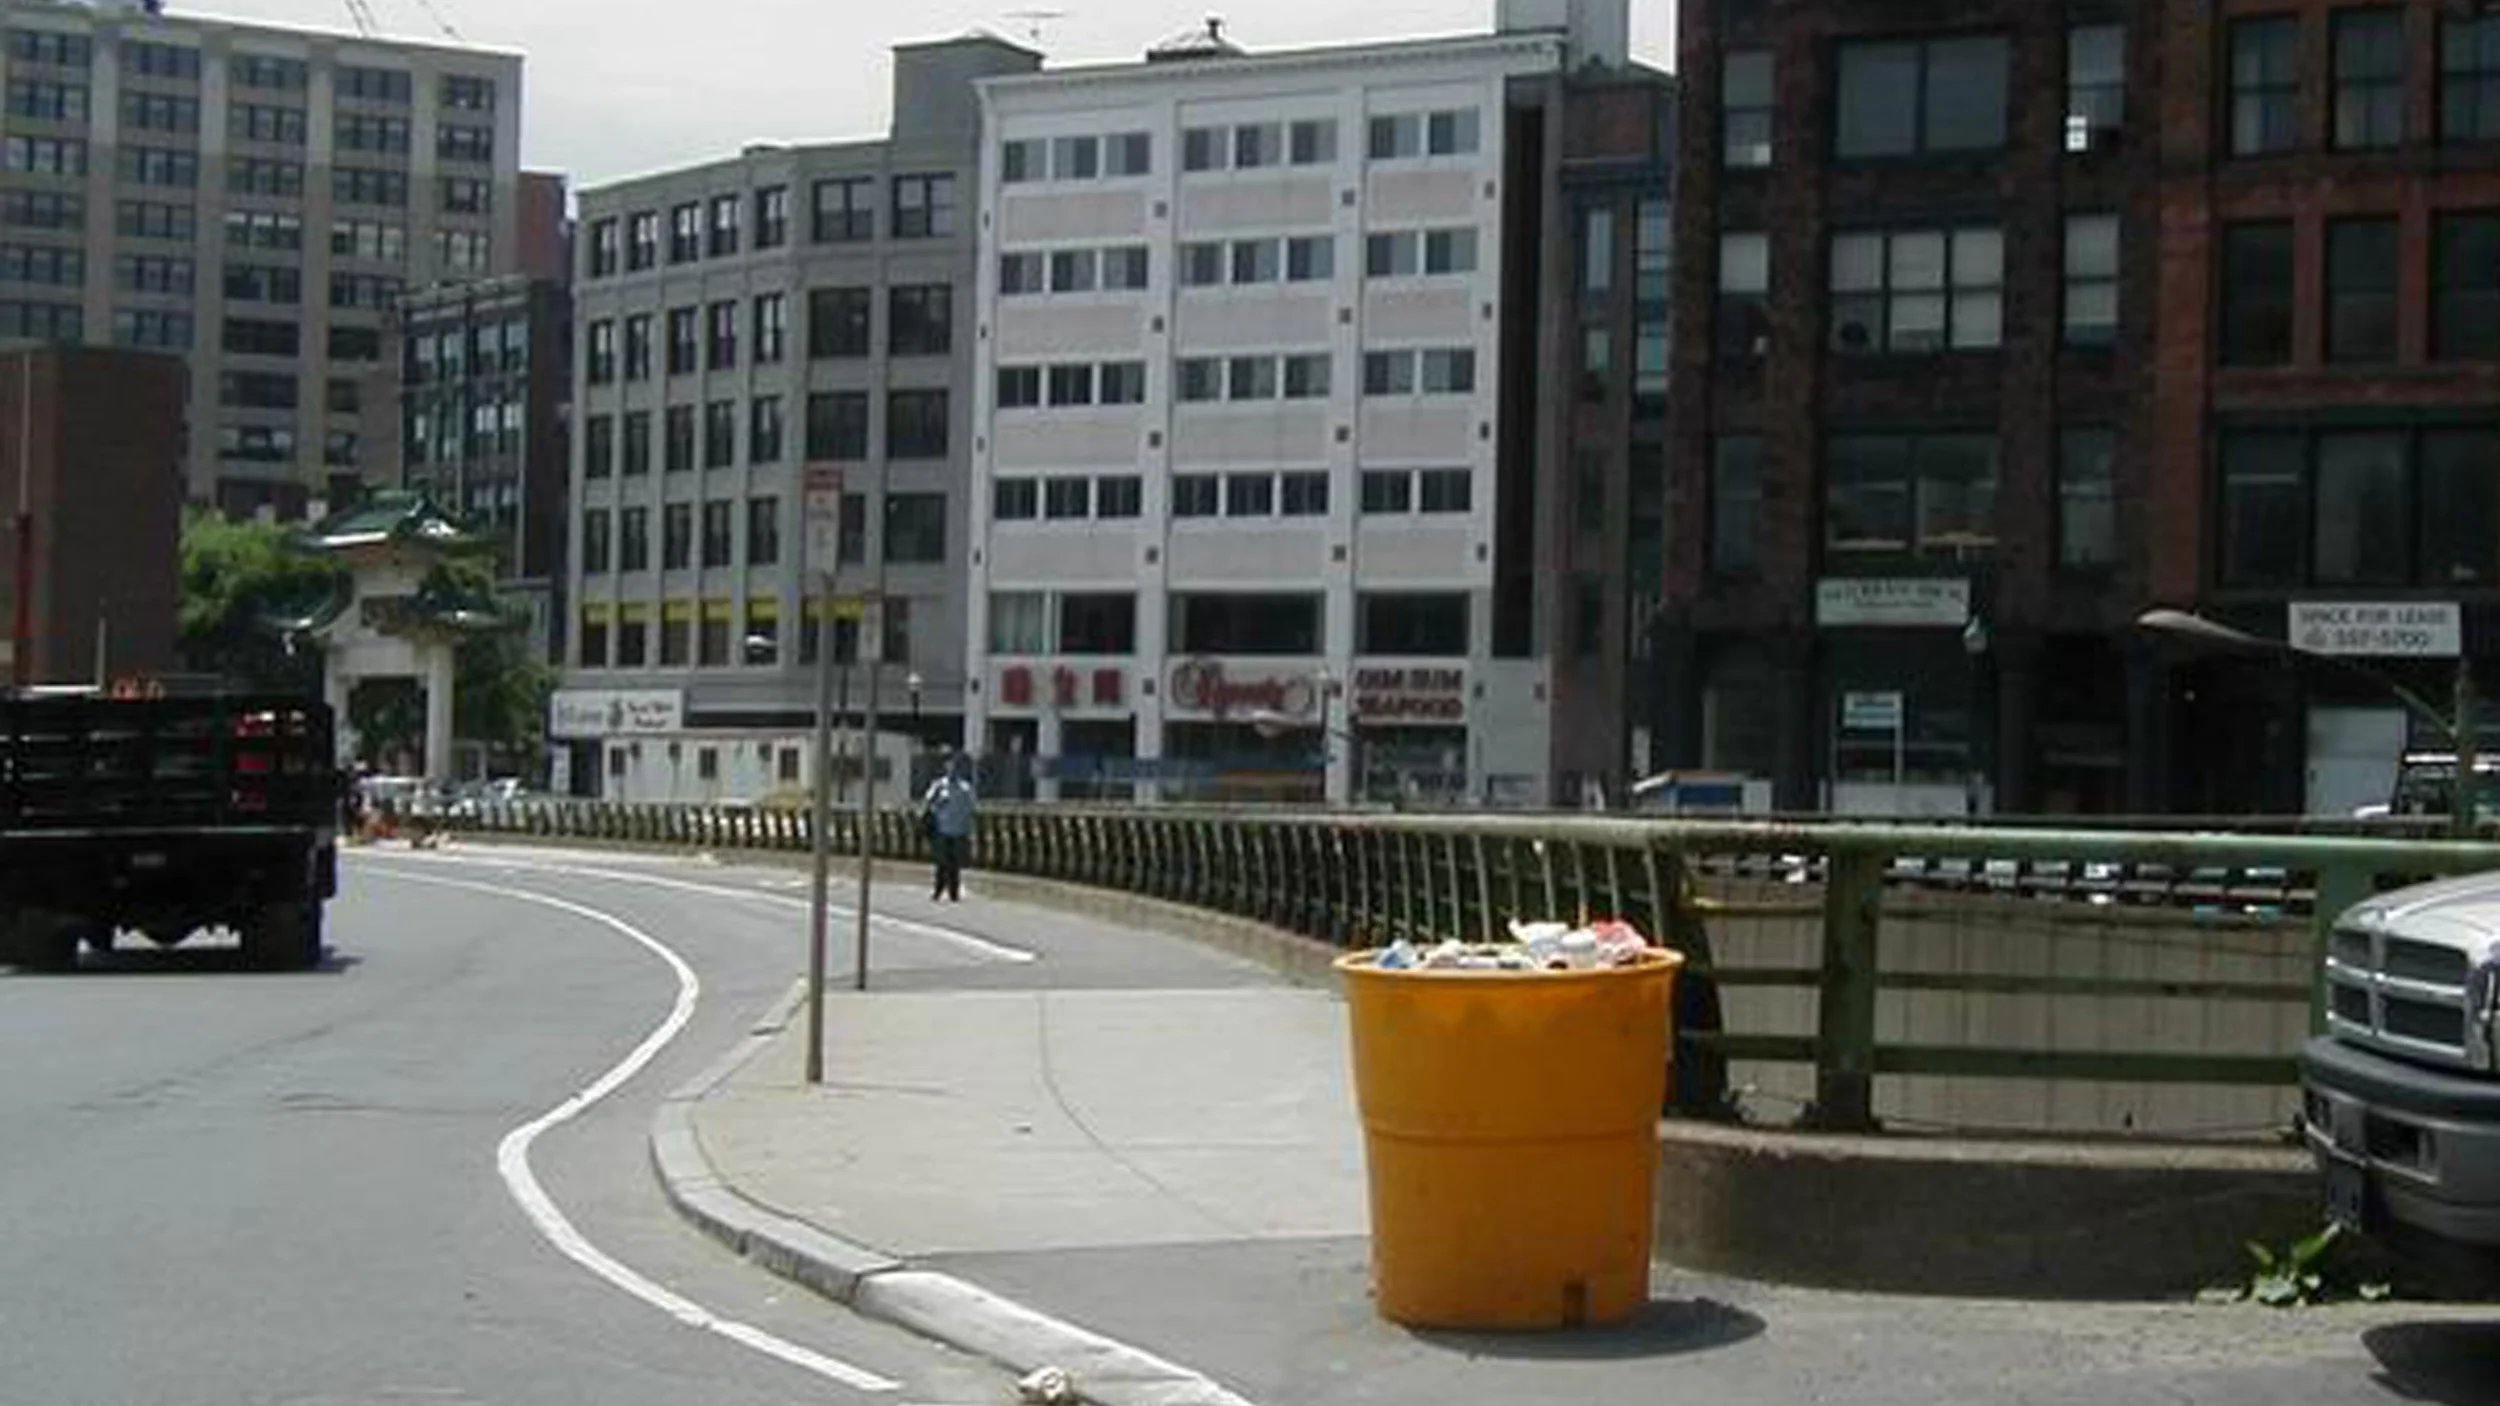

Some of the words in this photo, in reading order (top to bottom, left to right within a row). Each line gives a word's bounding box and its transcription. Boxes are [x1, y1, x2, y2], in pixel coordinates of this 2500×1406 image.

[2355, 607, 2390, 625] FOR
[2397, 606, 2449, 625] LEASE
[1355, 695, 1464, 718] SEAFOOD
